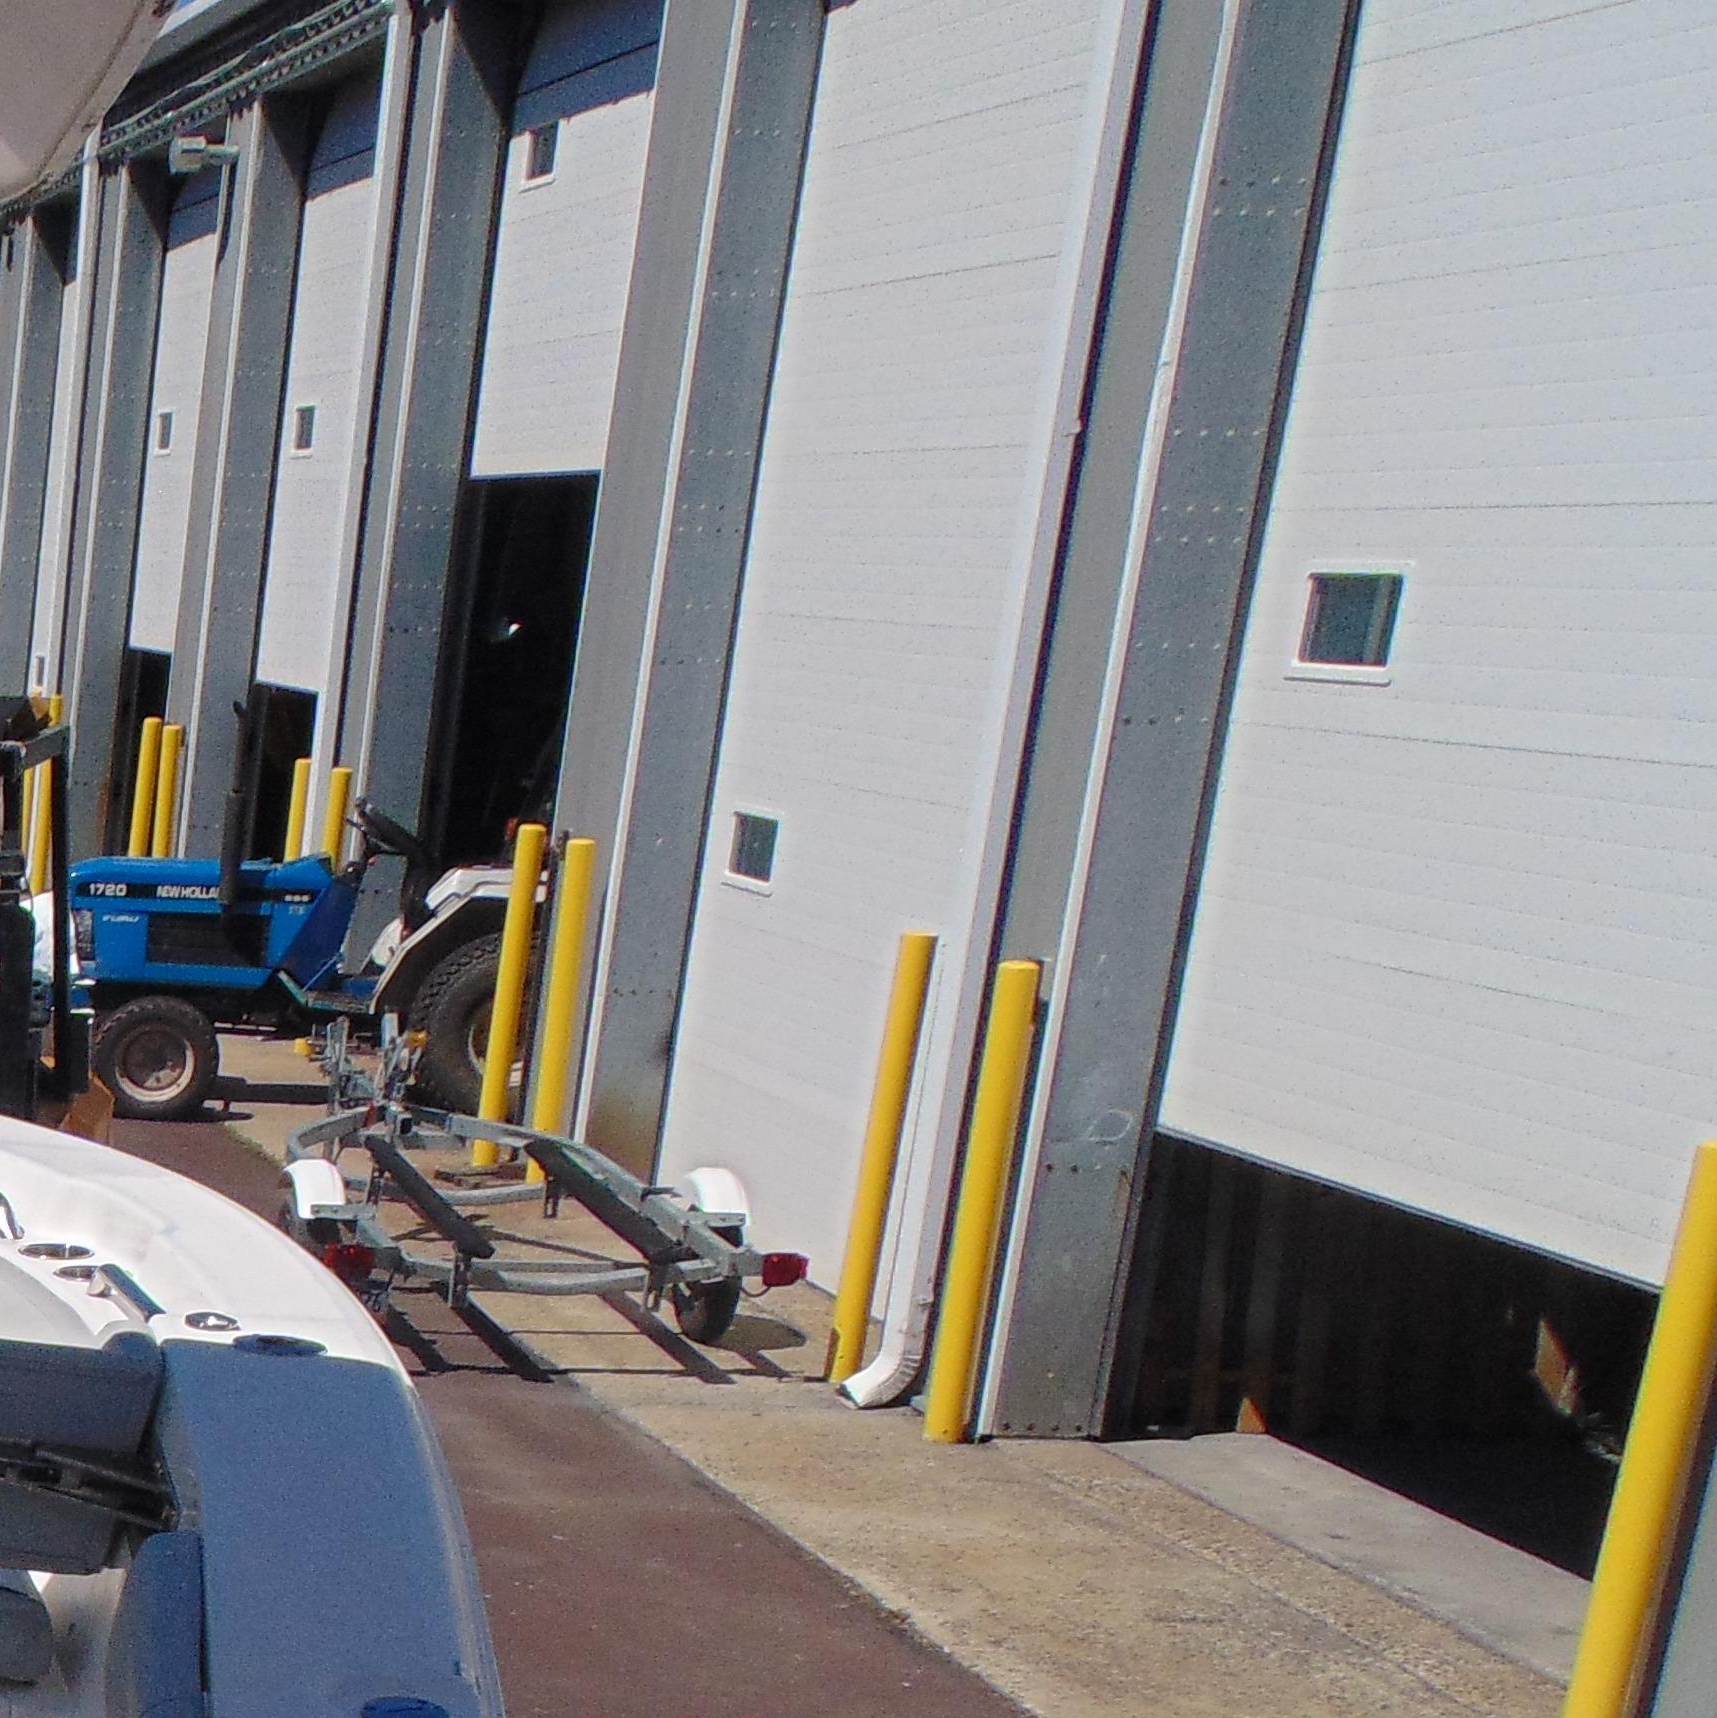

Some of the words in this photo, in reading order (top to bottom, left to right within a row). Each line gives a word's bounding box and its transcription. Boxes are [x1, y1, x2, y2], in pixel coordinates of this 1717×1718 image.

[88, 883, 127, 897] 1720
[156, 884, 180, 898] NEW
[181, 885, 220, 899] HOLLA
